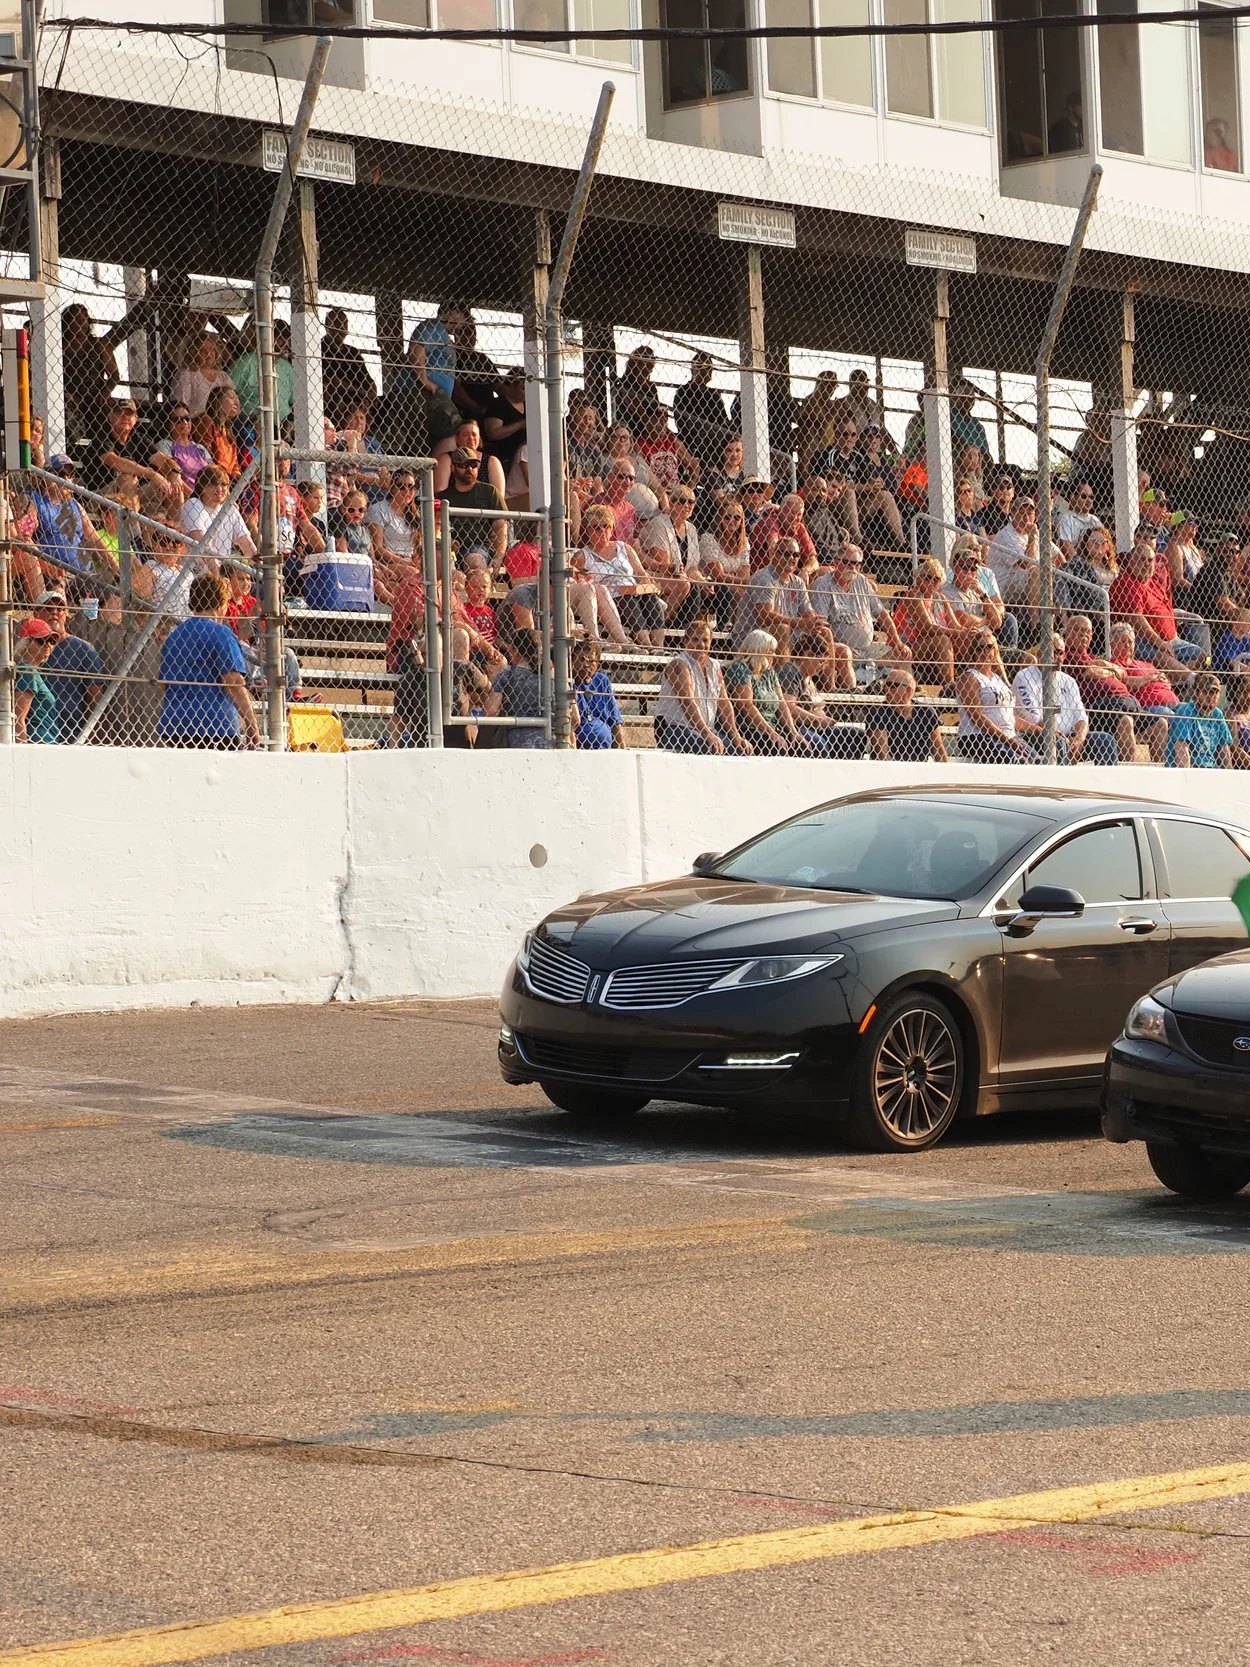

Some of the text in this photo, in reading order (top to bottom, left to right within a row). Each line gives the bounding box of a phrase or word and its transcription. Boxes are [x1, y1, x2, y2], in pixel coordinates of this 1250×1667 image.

[307, 141, 352, 165] SECTION
[721, 206, 793, 230] FAMILY SECTION
[908, 234, 973, 256] FAMILY SECTION
